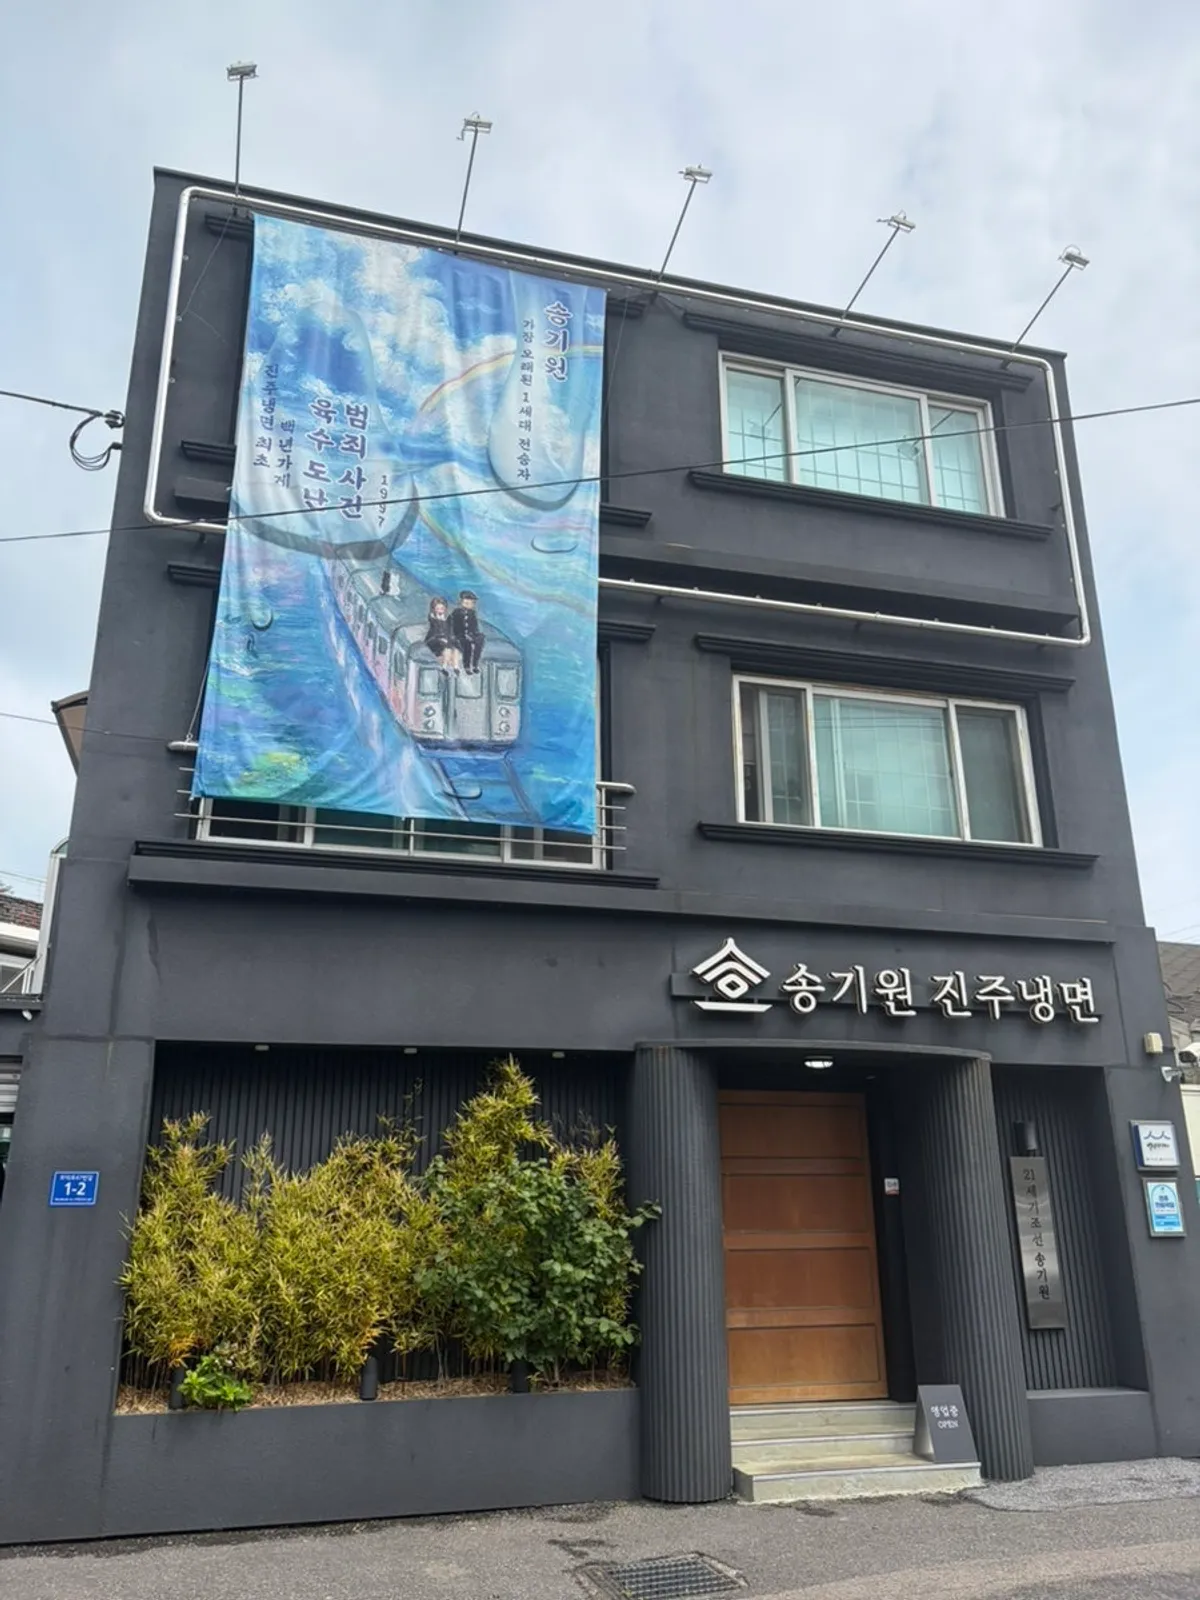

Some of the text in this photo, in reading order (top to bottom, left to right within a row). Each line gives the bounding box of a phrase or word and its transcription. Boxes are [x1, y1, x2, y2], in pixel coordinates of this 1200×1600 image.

[545, 301, 572, 382] 송기원
[253, 363, 279, 468] 진주냉면 최초
[517, 319, 535, 481] 가장 오래된 1세대 전승자
[274, 419, 296, 489] 백년가게
[377, 474, 389, 527] 1997
[782, 963, 1100, 1024] 송기원 진주냉면
[64, 1181, 87, 1197] 1-2
[930, 1404, 959, 1418] 영업중
[937, 1420, 959, 1429] OPEN
